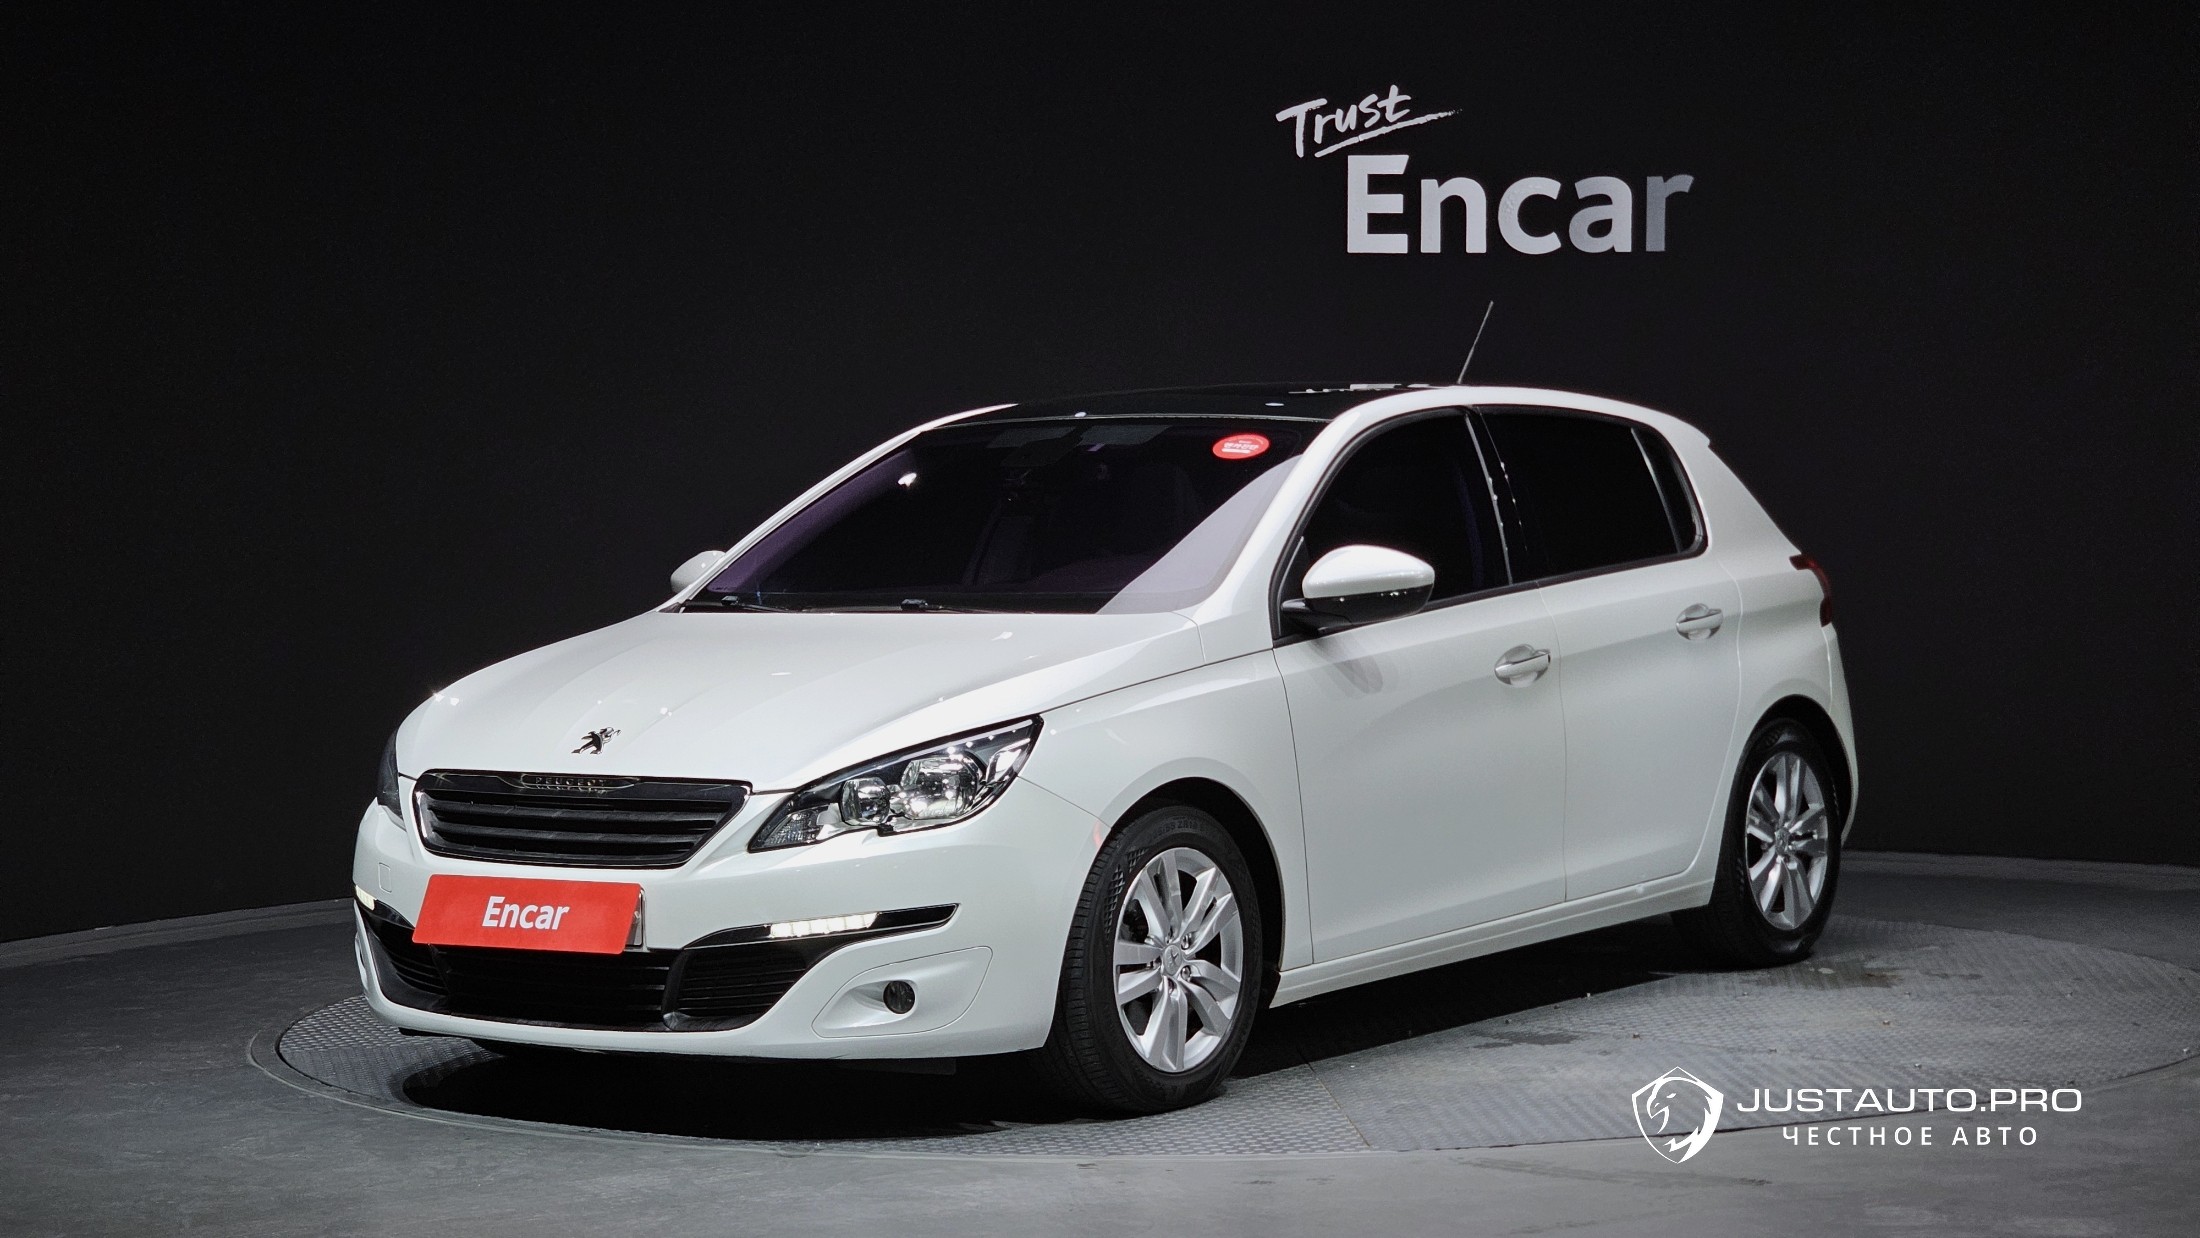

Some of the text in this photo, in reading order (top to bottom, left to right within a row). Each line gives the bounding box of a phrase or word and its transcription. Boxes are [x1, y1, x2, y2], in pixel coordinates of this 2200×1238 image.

[1276, 85, 1412, 158] Trust
[1347, 154, 1695, 255] Encar
[482, 895, 570, 930] Encar
